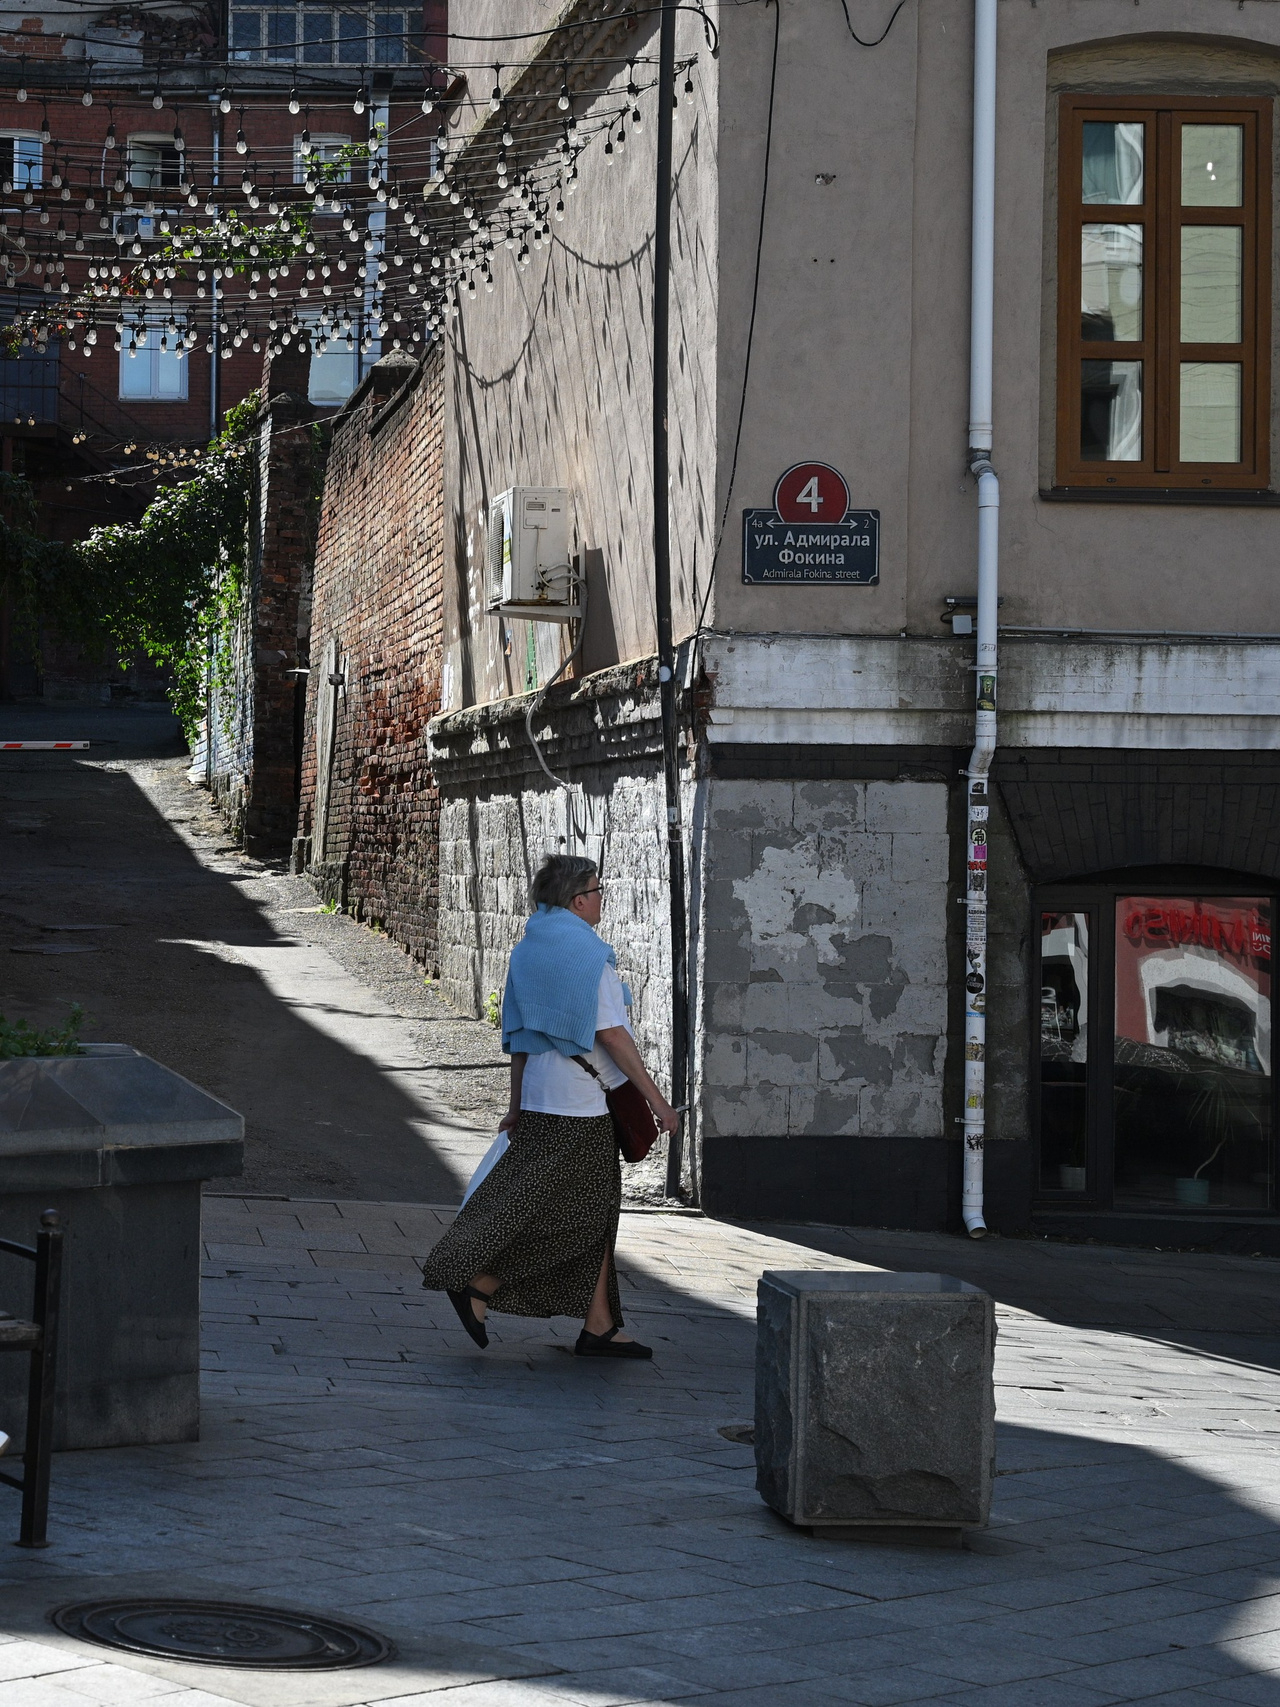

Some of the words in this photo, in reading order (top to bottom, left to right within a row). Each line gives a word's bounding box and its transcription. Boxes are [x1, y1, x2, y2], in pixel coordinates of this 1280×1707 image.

[796, 476, 824, 513] 4
[863, 519, 870, 529] 2
[754, 533, 779, 550] ул.
[784, 530, 870, 549] Адмирала
[778, 548, 845, 564] Фокина
[762, 568, 802, 579] Admirala
[804, 568, 832, 579] Fokina
[835, 569, 860, 579] street
